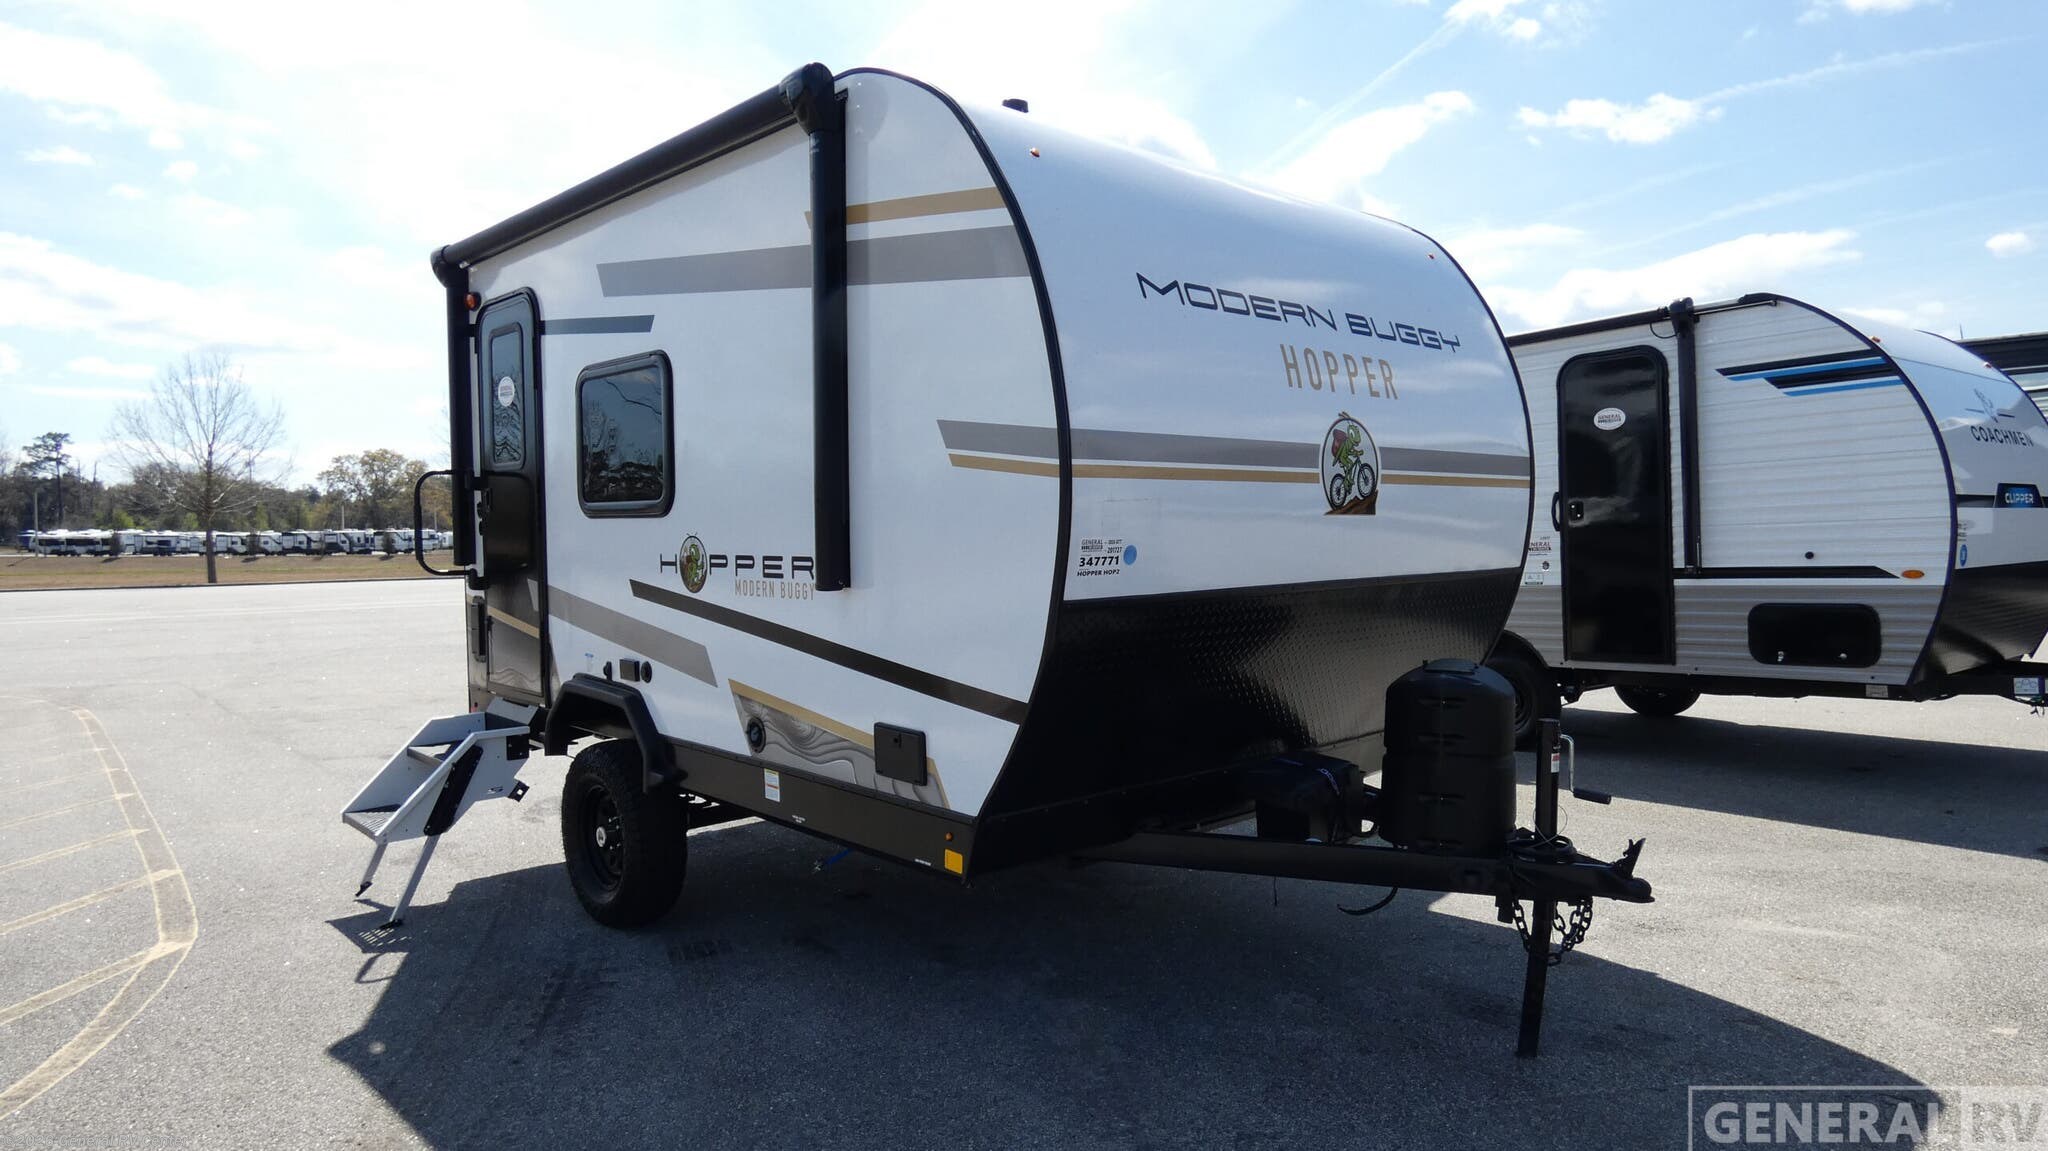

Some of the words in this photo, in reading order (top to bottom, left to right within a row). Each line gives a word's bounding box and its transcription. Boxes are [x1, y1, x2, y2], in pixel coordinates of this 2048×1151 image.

[1136, 272, 1337, 331] MODERN
[1345, 312, 1461, 352] BUGGY
[1279, 343, 1398, 400] HOPPER
[1970, 425, 2035, 447] COACHMEN
[2004, 492, 2034, 505] CLIPPER
[1079, 555, 1120, 567] 347771
[735, 579, 775, 599] MODERN
[780, 582, 815, 601] BUGGY
